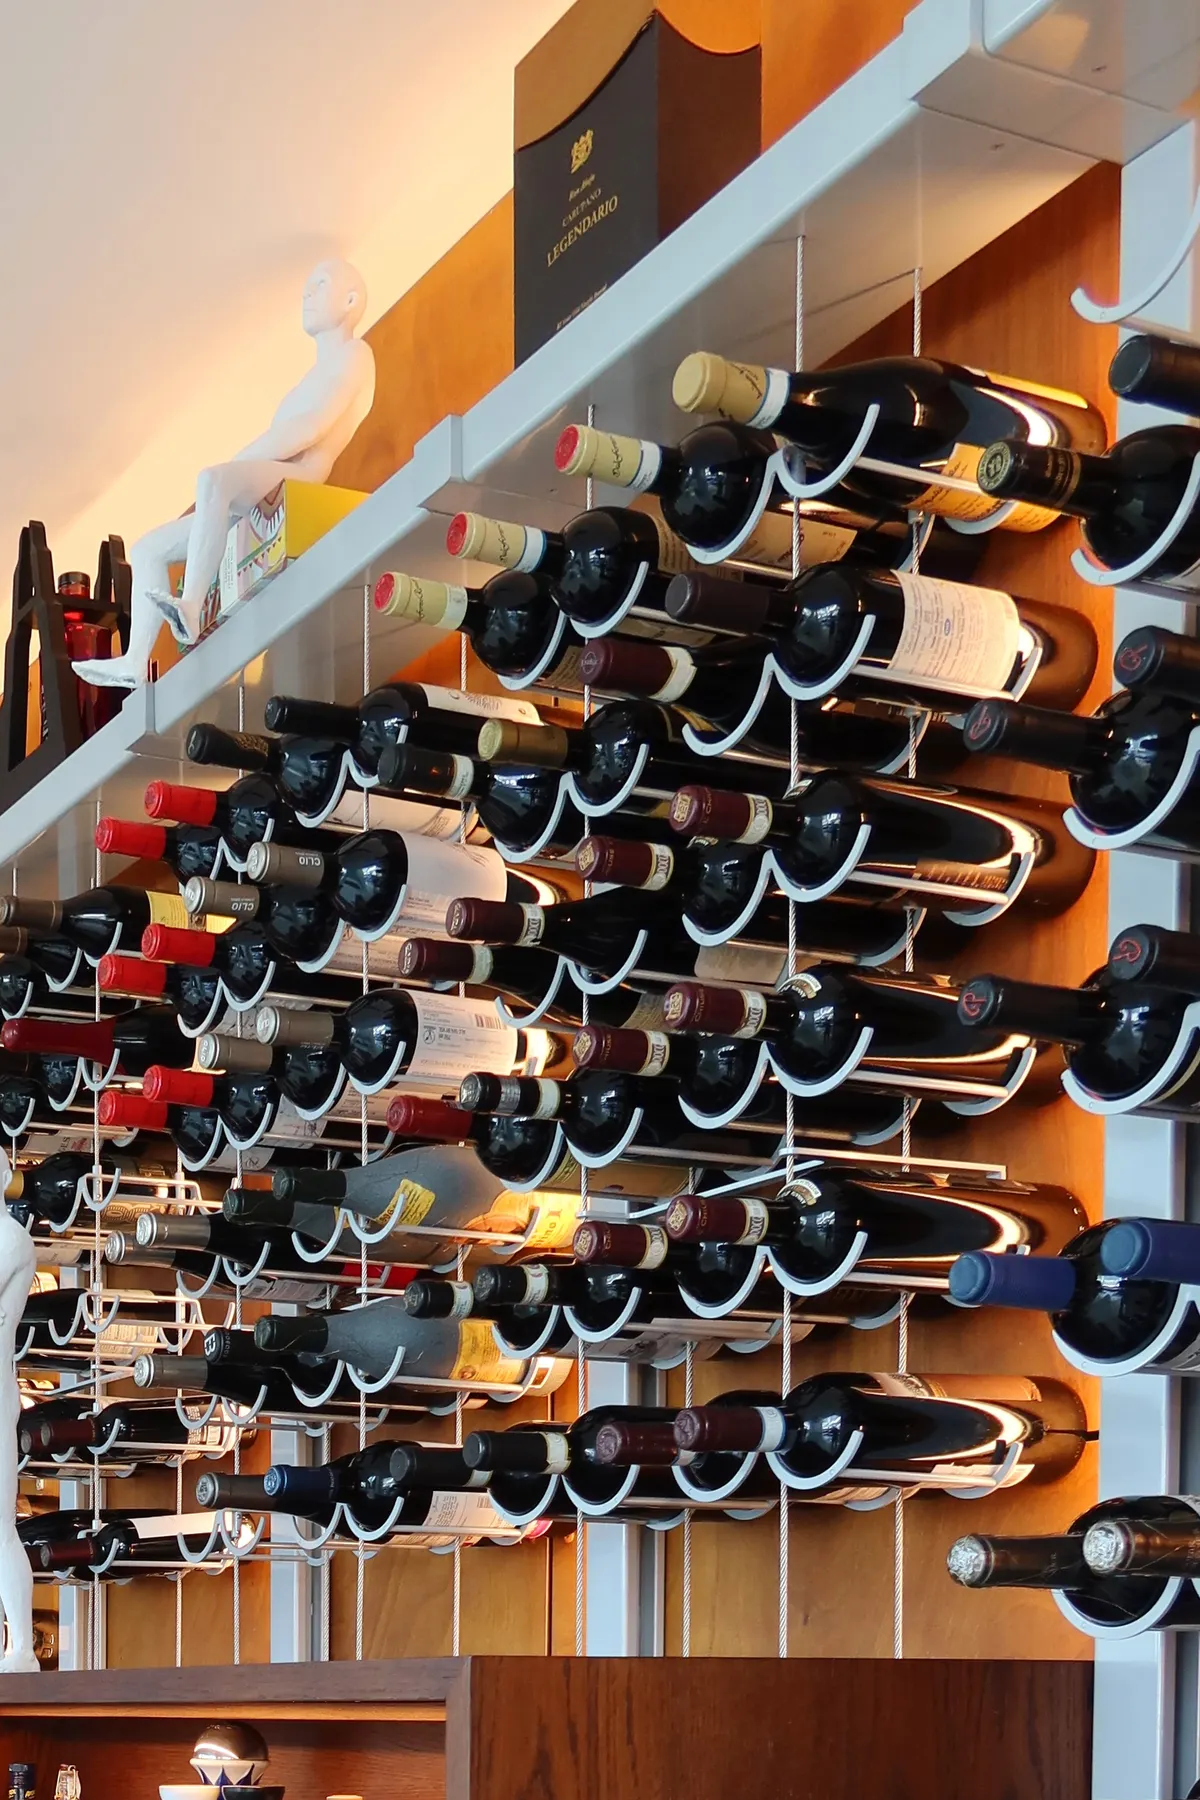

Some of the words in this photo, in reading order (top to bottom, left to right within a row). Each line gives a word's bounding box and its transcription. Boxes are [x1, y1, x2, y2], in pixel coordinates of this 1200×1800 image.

[547, 194, 618, 267] LEGENDARIO
[299, 856, 322, 867] CLIO
[231, 901, 255, 912] CLIO
